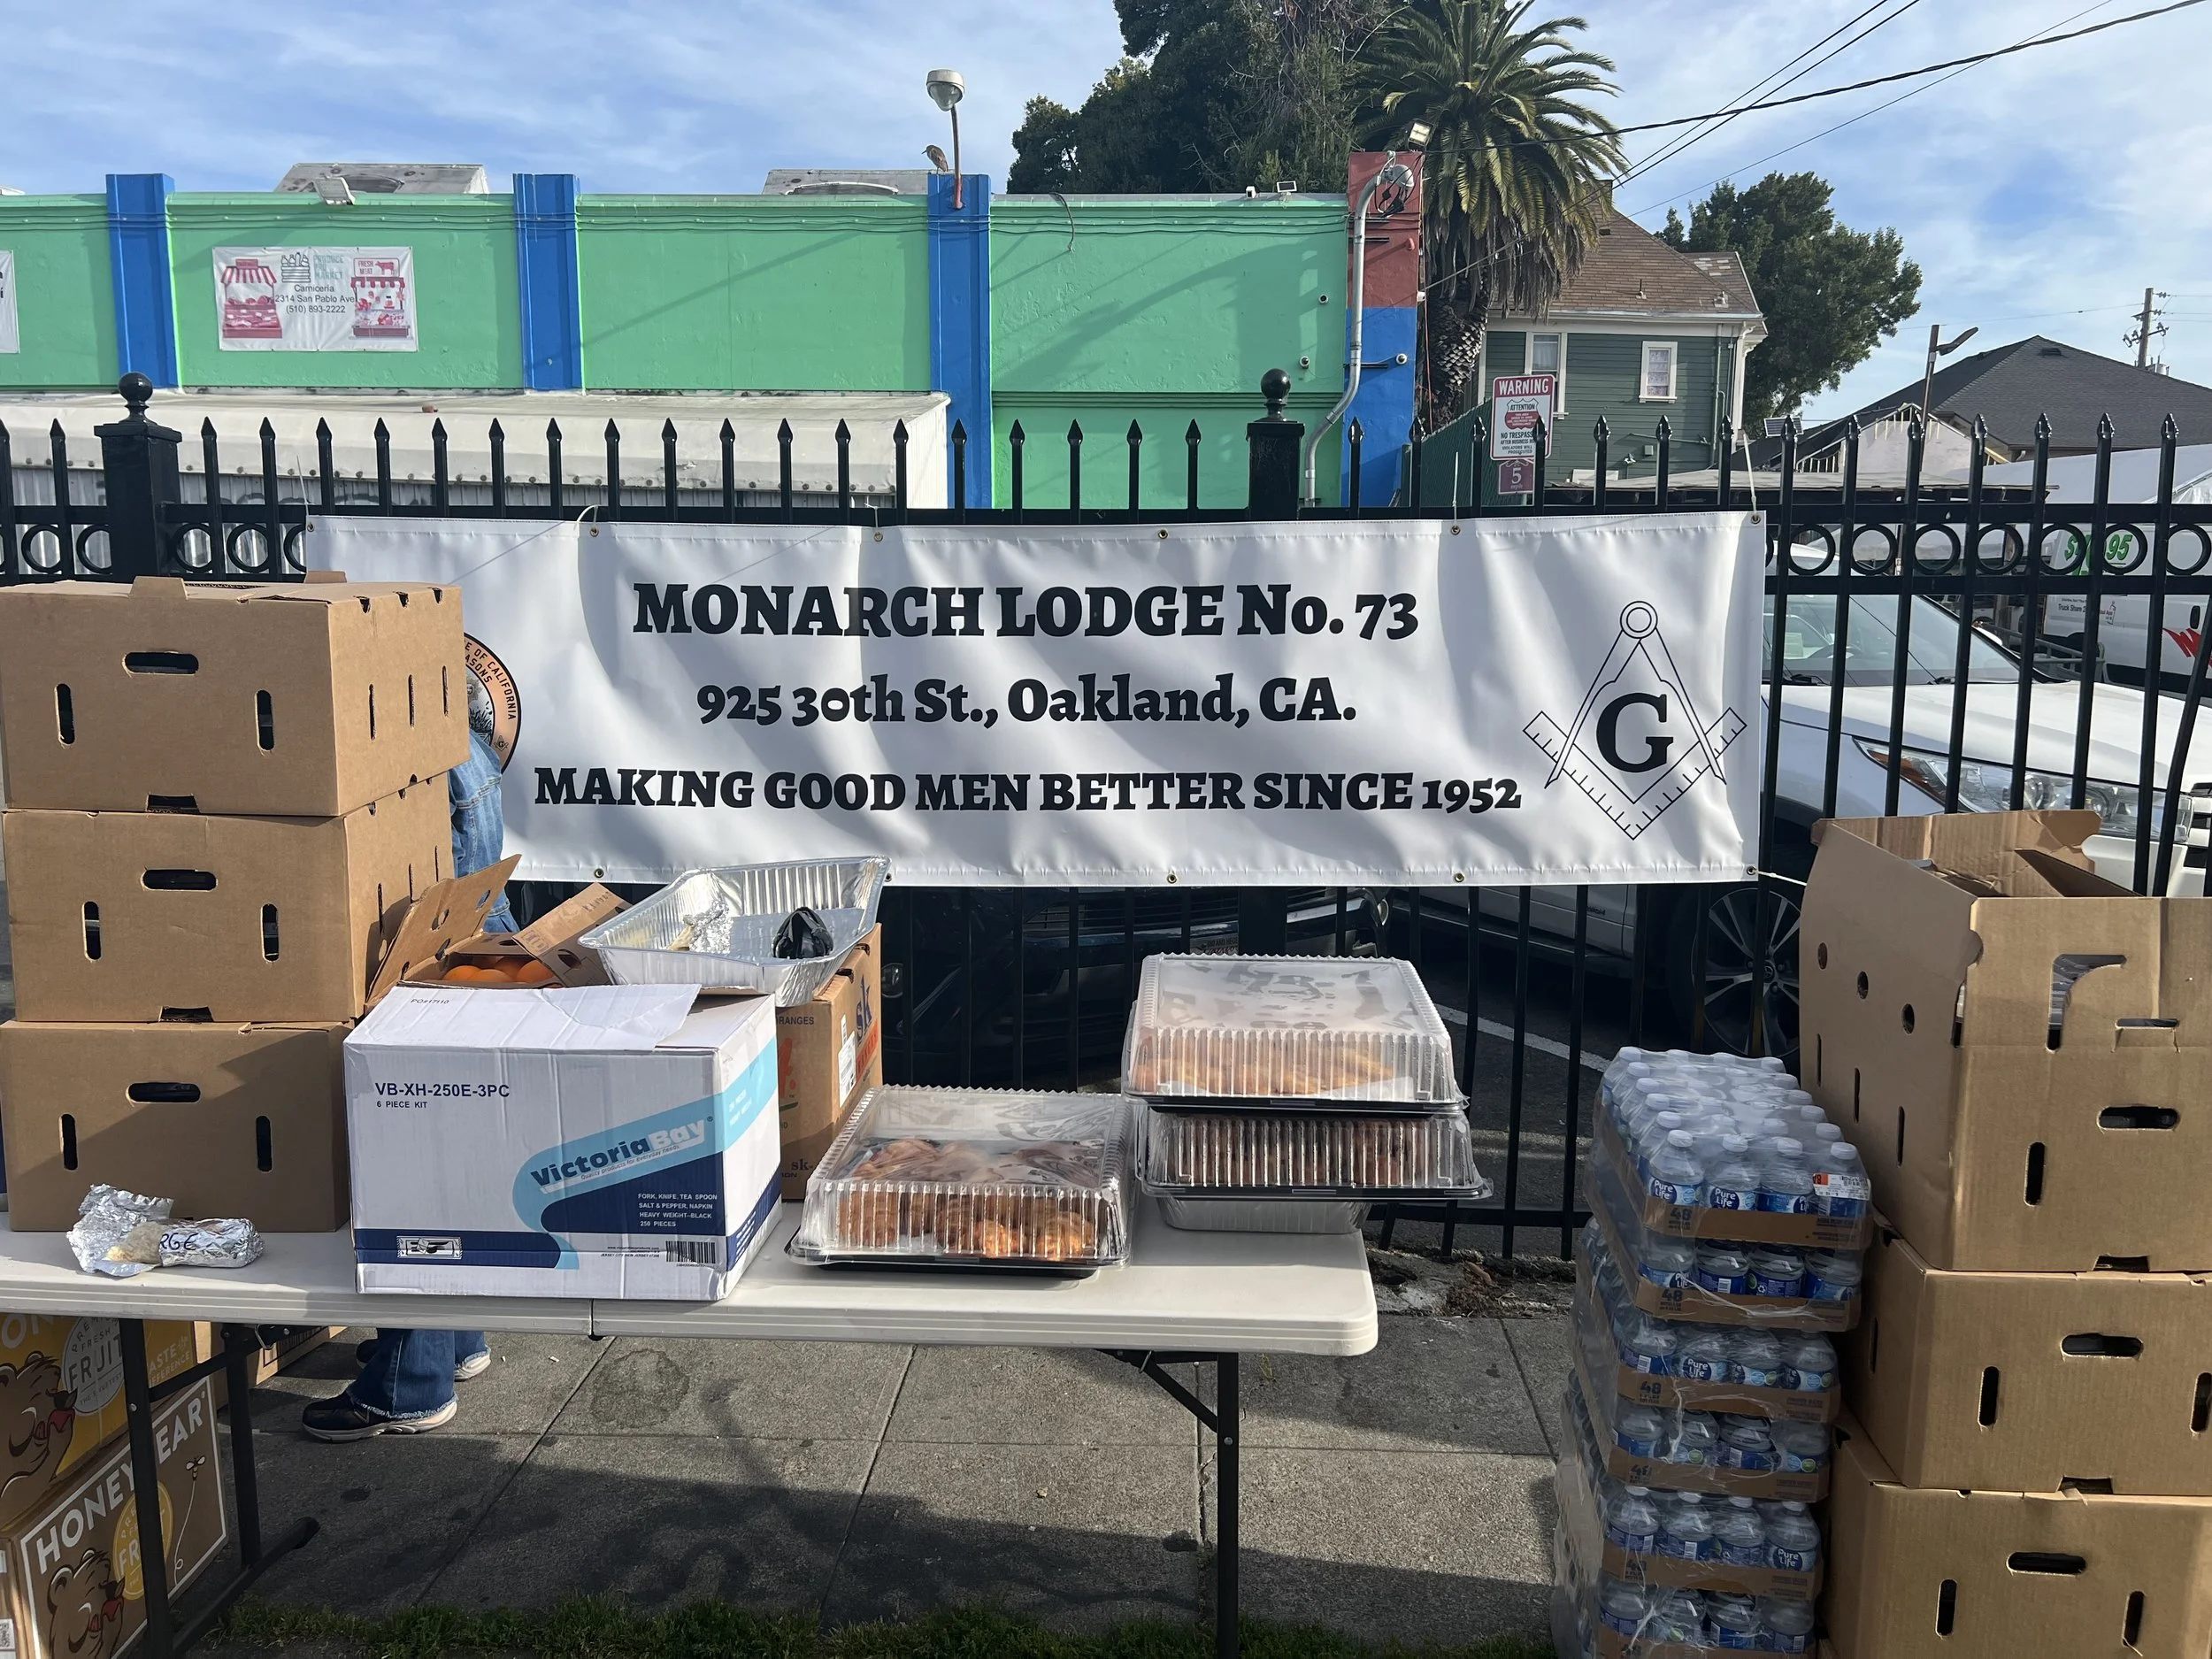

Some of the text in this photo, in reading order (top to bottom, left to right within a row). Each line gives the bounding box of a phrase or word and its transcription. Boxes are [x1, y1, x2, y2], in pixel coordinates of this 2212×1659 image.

[286, 305, 307, 314] (510)
[1499, 378, 1549, 396] WARNING
[1511, 467, 1522, 484] 5
[633, 582, 1418, 641] MONARCH LODGE No. 73
[465, 654, 493, 684] ASONS
[474, 648, 517, 720] OF CALIFORNIA
[696, 672, 1356, 729] 925 30th St., Oakland, CA.
[1595, 692, 1674, 773] G
[534, 767, 1522, 814] MAKING GOOD MEN BETTER SINCE 1952
[776, 1016, 815, 1025] RANGES
[374, 1082, 511, 1098] VB-XH-250E-3PC
[580, 1171, 600, 1180] Quality
[601, 1162, 626, 1174] products
[636, 1150, 661, 1163] everyday
[662, 1144, 680, 1154] needs
[1654, 1179, 1673, 1192] Pure
[1655, 1187, 1671, 1200] Life
[1715, 1187, 1736, 1201] Pure
[1716, 1196, 1732, 1208] Life
[1662, 1288, 1683, 1302] 48
[81, 1329, 111, 1352] FRESH
[68, 1333, 121, 1391] FRUIT
[150, 1343, 177, 1371] ASTE
[1687, 1357, 1709, 1371] Pure
[1688, 1366, 1705, 1378] Life
[1640, 1380, 1662, 1394] 48
[1778, 1548, 1799, 1561] Pure
[1778, 1557, 1796, 1568] Life
